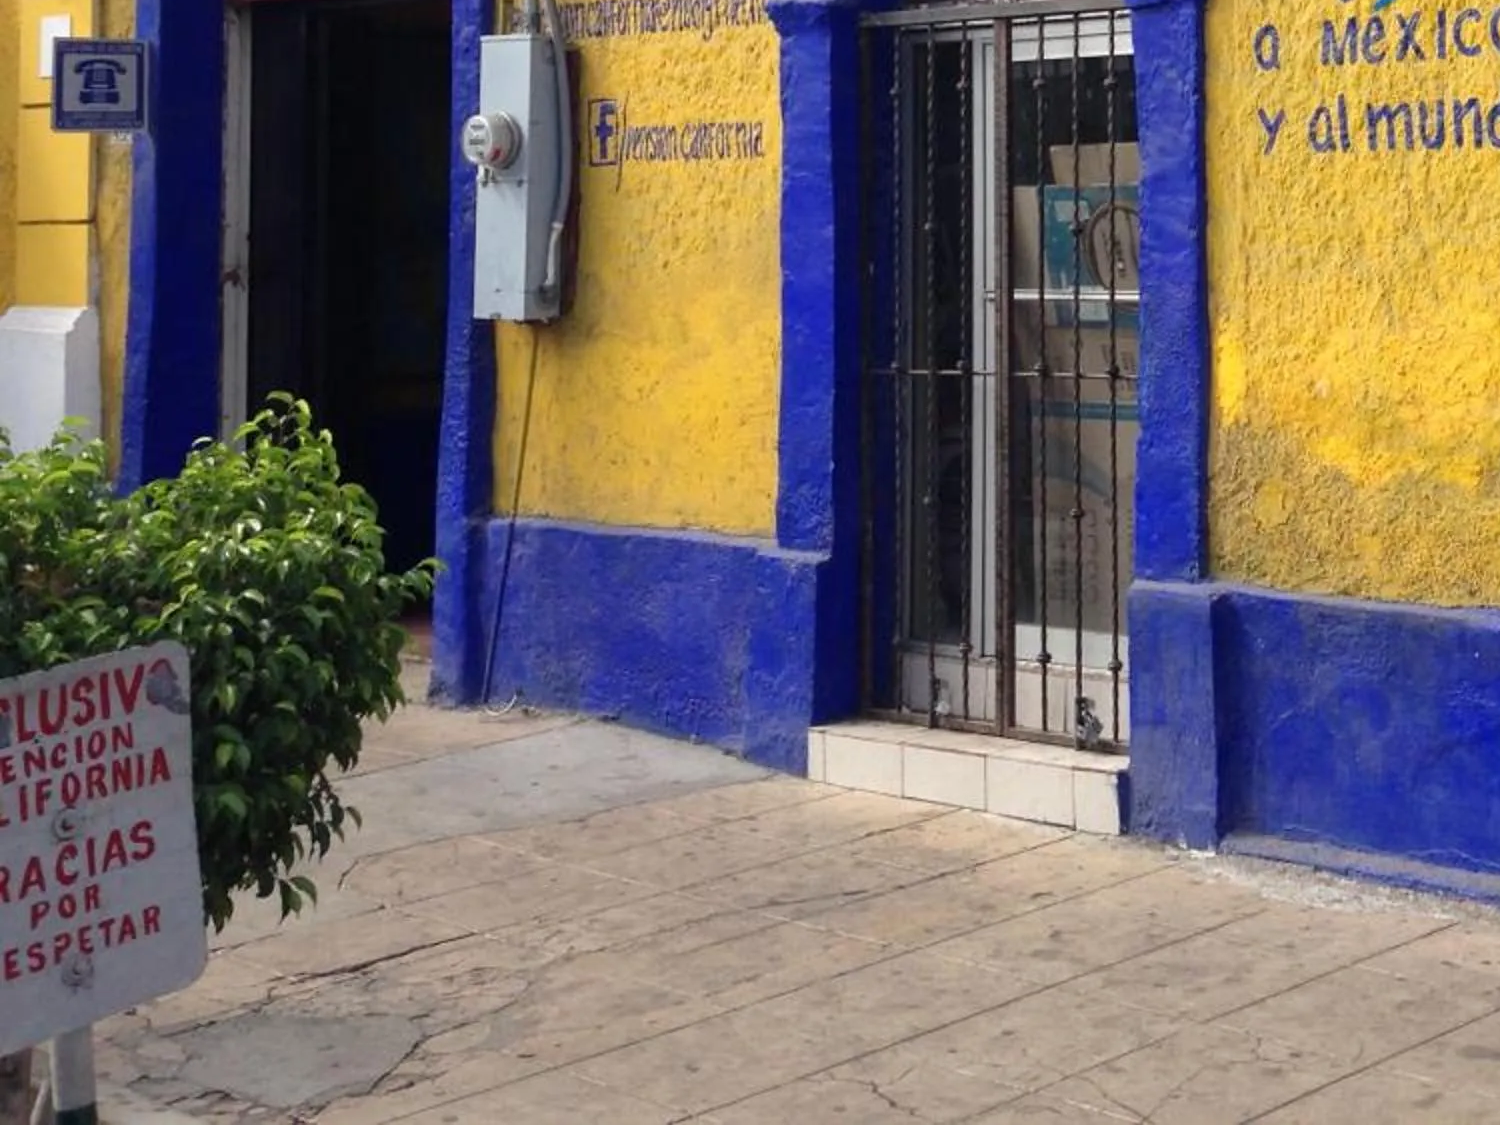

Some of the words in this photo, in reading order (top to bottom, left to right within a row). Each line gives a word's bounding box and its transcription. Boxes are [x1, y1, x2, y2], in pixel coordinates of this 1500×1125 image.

[1253, 23, 1280, 73] a
[1308, 93, 1350, 153] al
[30, 883, 100, 931] POR
[3, 904, 161, 981] ESPETAR
